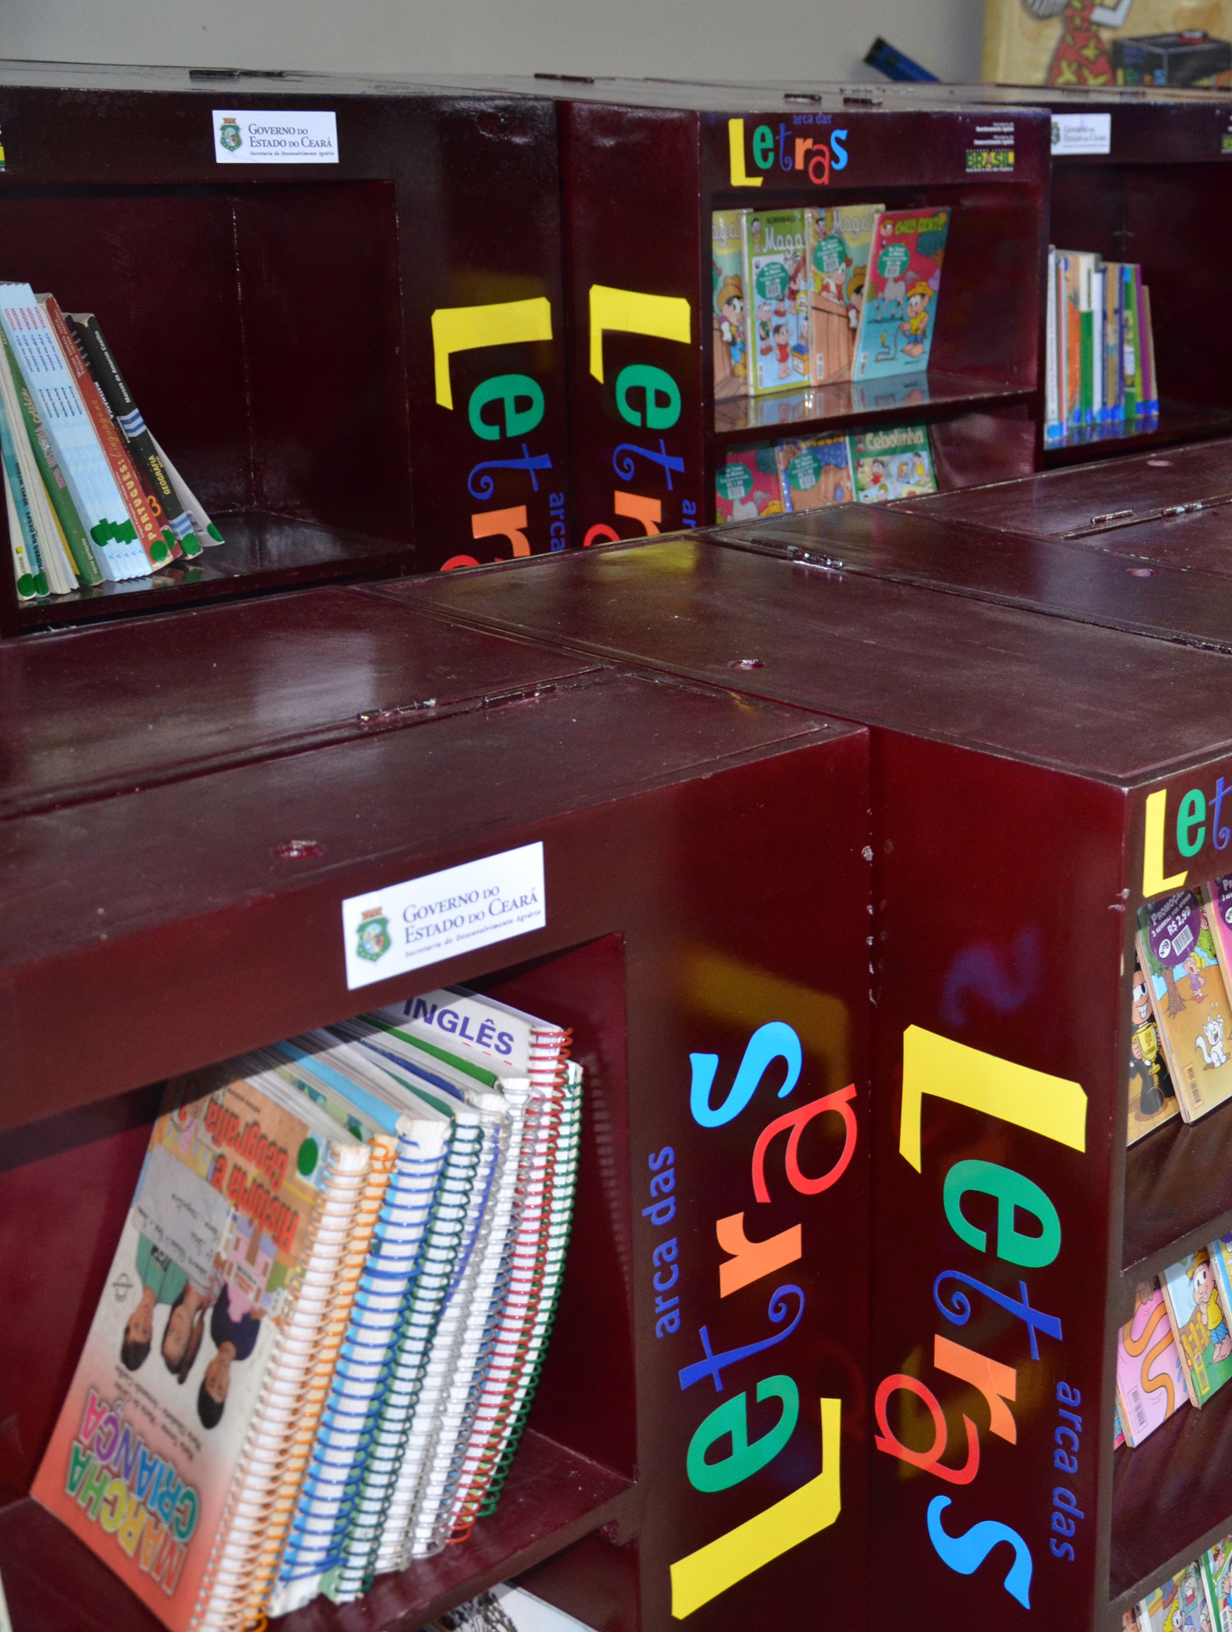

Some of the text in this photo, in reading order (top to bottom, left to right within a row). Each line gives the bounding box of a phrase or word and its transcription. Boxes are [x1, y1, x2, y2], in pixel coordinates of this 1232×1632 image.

[250, 136, 287, 148] ESTADO
[301, 136, 332, 148] CEARÁ
[792, 112, 832, 126] arca das
[728, 118, 848, 186] Letras
[94, 330, 132, 404] Marcos de Amorim Coelho
[94, 382, 114, 420] MATEMÁTICA
[92, 399, 157, 540] PORTUGUÊS: Linguagens
[866, 427, 924, 450] Cebolinha
[147, 496, 162, 517] 3
[148, 454, 170, 496] GEOGRAFIA
[402, 890, 480, 924] GOVERNO
[404, 914, 464, 944] ESTADO
[488, 888, 538, 916] CEARÁ
[1167, 906, 1191, 936] R$ 2,99
[402, 997, 514, 1056] INGLÊS
[204, 1102, 289, 1193] Geografia
[212, 1156, 228, 1190] e
[228, 1163, 298, 1254] História
[642, 1146, 679, 1338] arca das
[670, 1021, 857, 1620] Letras
[874, 1024, 1088, 1610] Letras
[80, 1387, 200, 1542] CRIANÇA
[1051, 1380, 1085, 1562] arca das
[65, 1440, 188, 1597] MARCHA
